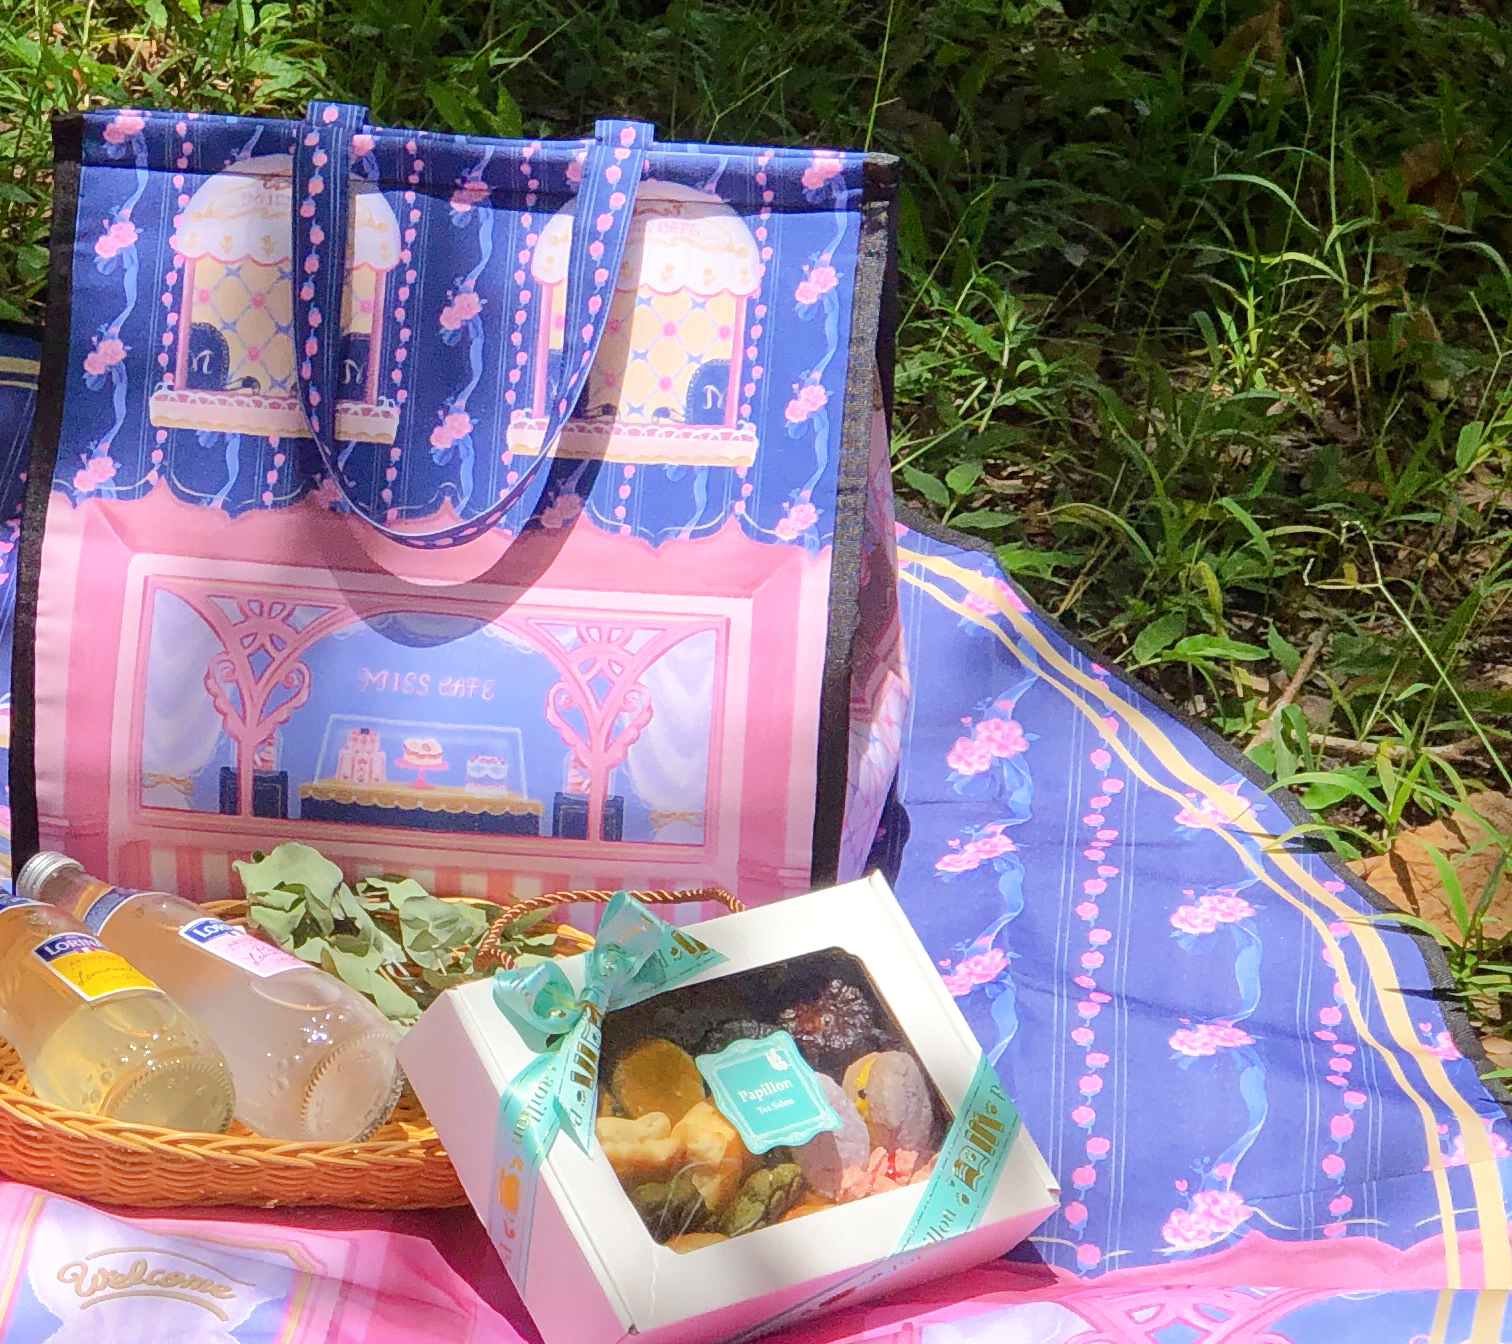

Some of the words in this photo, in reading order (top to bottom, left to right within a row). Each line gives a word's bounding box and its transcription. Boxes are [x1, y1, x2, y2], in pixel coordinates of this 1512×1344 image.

[358, 666, 431, 696] MISS
[737, 1079, 794, 1103] Papillon
[57, 1258, 236, 1300] Welcome
